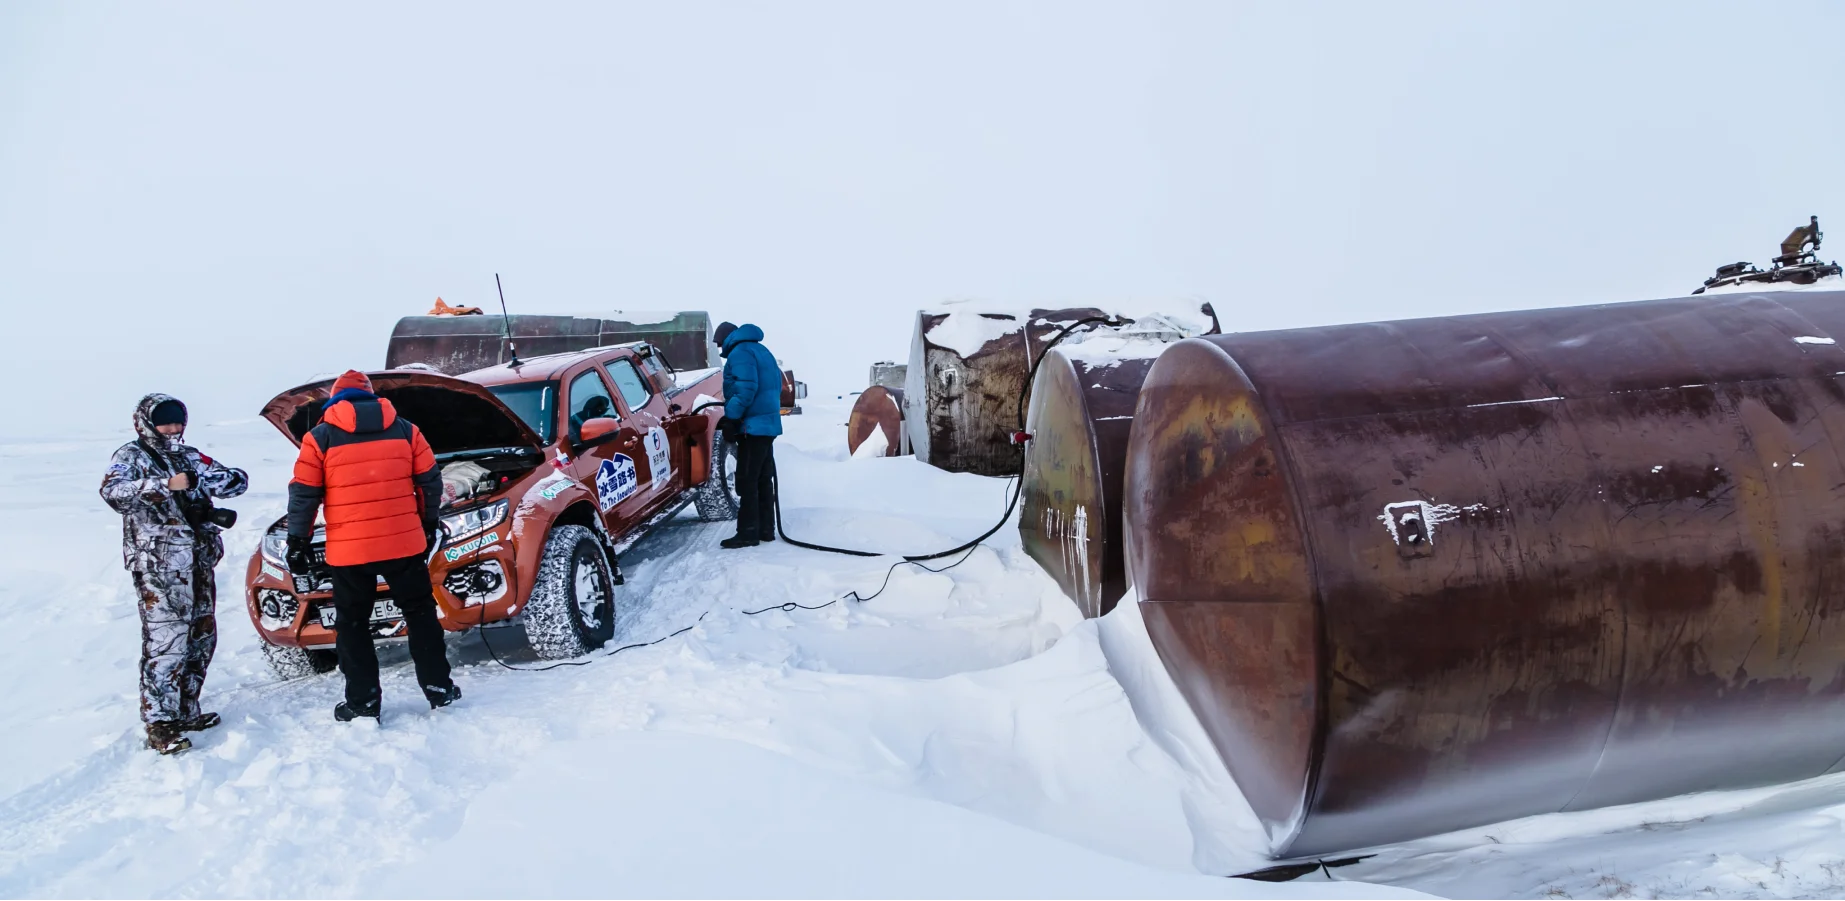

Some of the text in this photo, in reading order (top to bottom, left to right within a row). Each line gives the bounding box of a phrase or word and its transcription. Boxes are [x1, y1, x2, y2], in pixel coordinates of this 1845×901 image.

[598, 466, 636, 498] 冰雪路书
[601, 483, 637, 510] To The Snowland
[460, 533, 498, 554] KUCOIN
